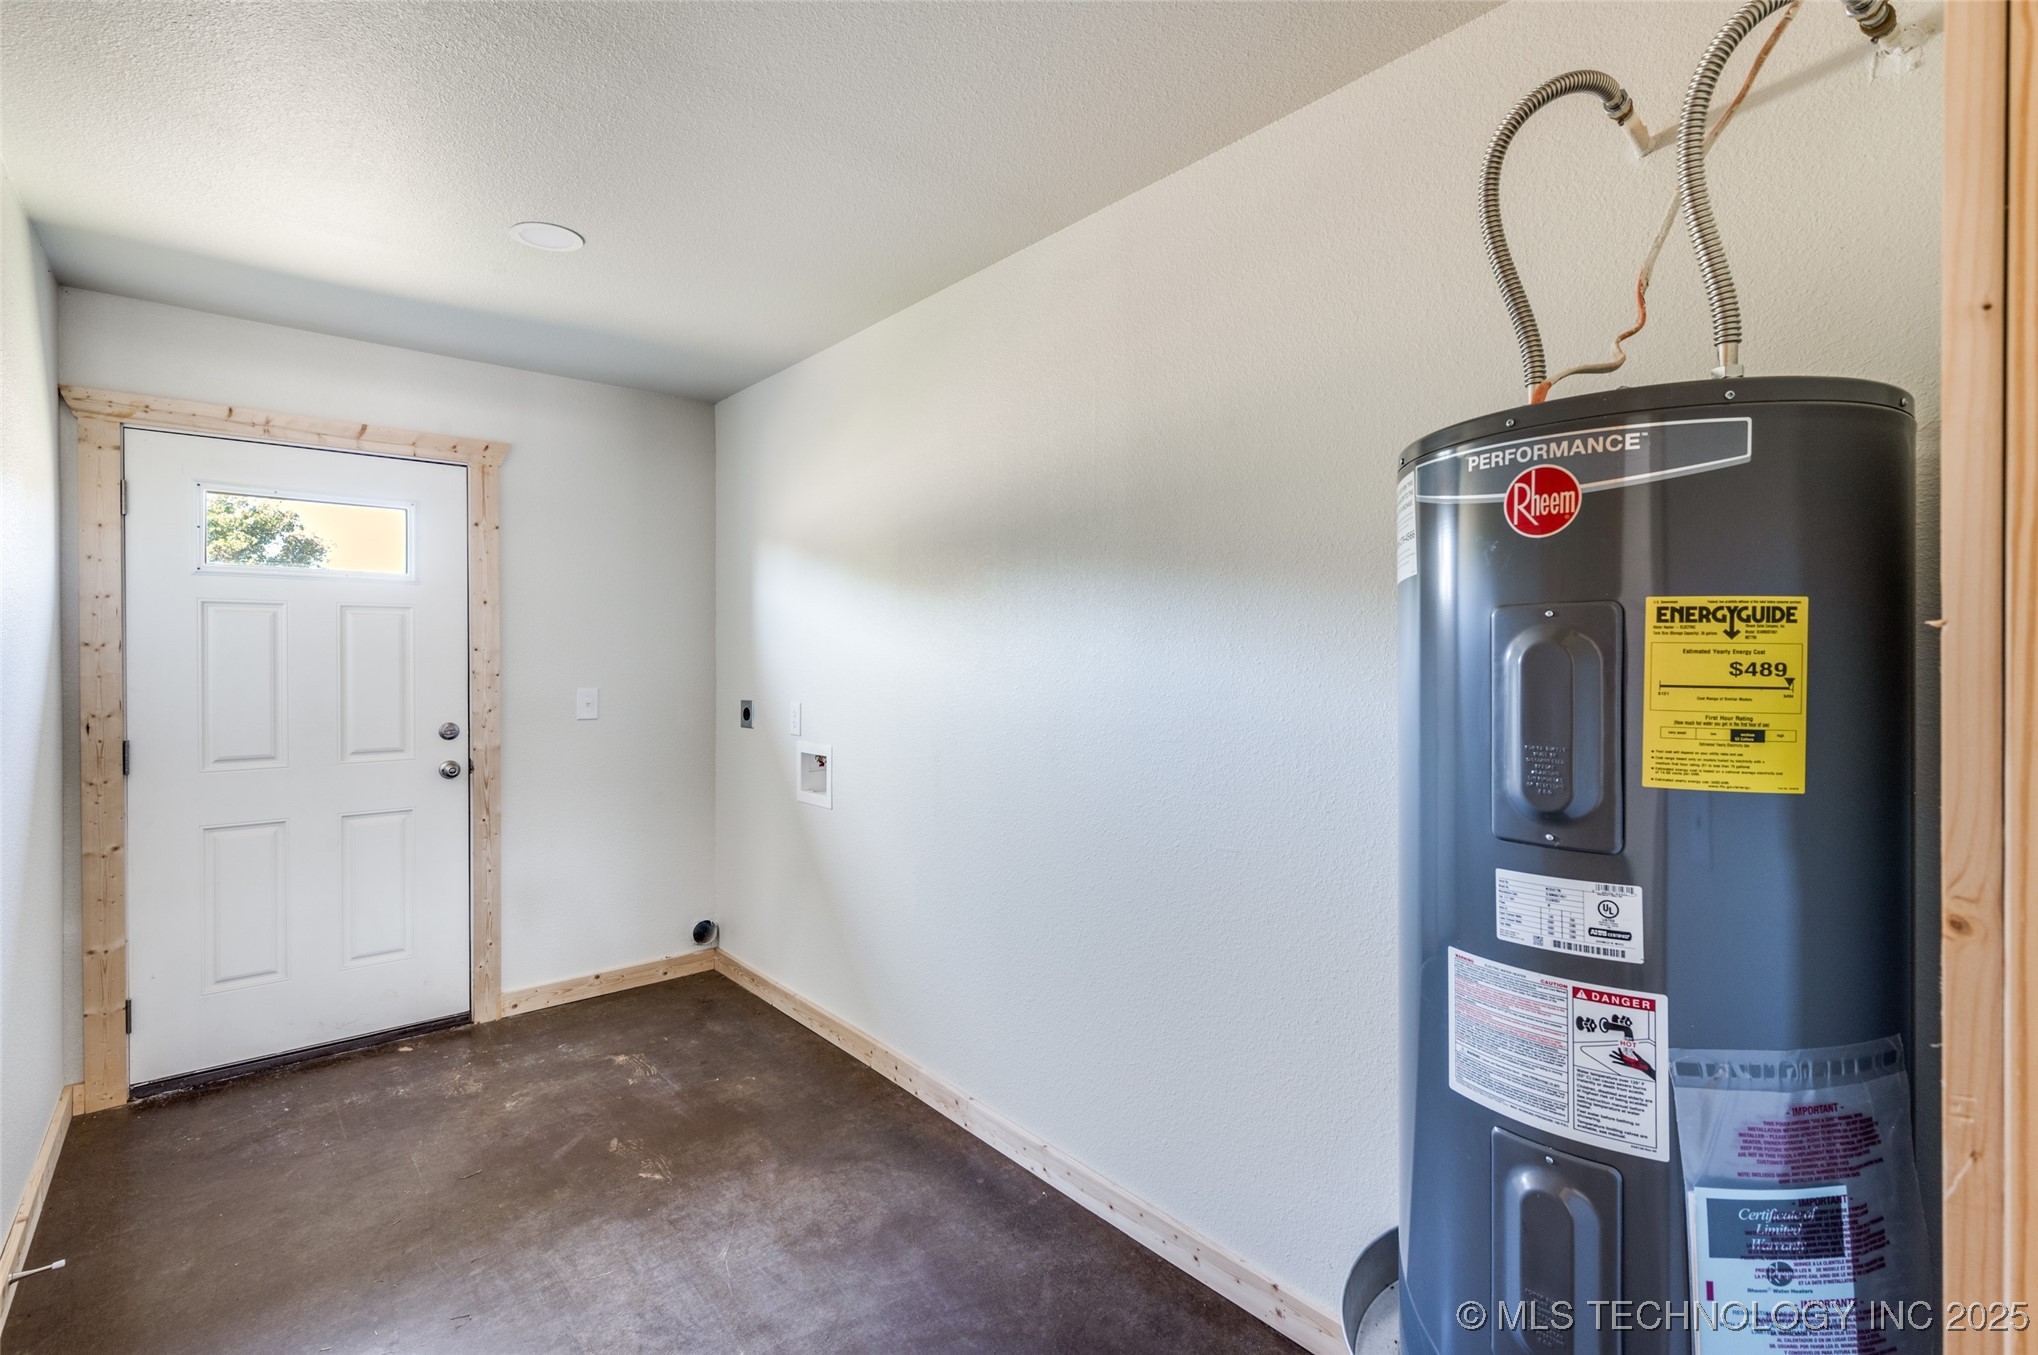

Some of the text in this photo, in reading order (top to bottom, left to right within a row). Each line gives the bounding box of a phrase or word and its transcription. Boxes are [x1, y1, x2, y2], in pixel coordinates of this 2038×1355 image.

[1513, 470, 1576, 526] Rheem
[1656, 606, 1798, 624] ENERGYGUIDE
[1729, 661, 1787, 678] $489
[1602, 904, 1614, 915] UL
[1540, 979, 1568, 989] CAUTION
[1591, 992, 1650, 1010] DANGER
[1590, 1072, 1617, 1081] temperature
[1586, 1096, 1610, 1105] instruction
[1593, 1102, 1620, 1112] temperature
[1792, 1103, 1838, 1117] IMPORTANT
[1577, 1119, 1605, 1129] Temperature
[1606, 1126, 1623, 1134] limiting
[1616, 1118, 1634, 1126] bathing
[1798, 1194, 1848, 1207] IMPORTANT
[1804, 1206, 1818, 1219] of
